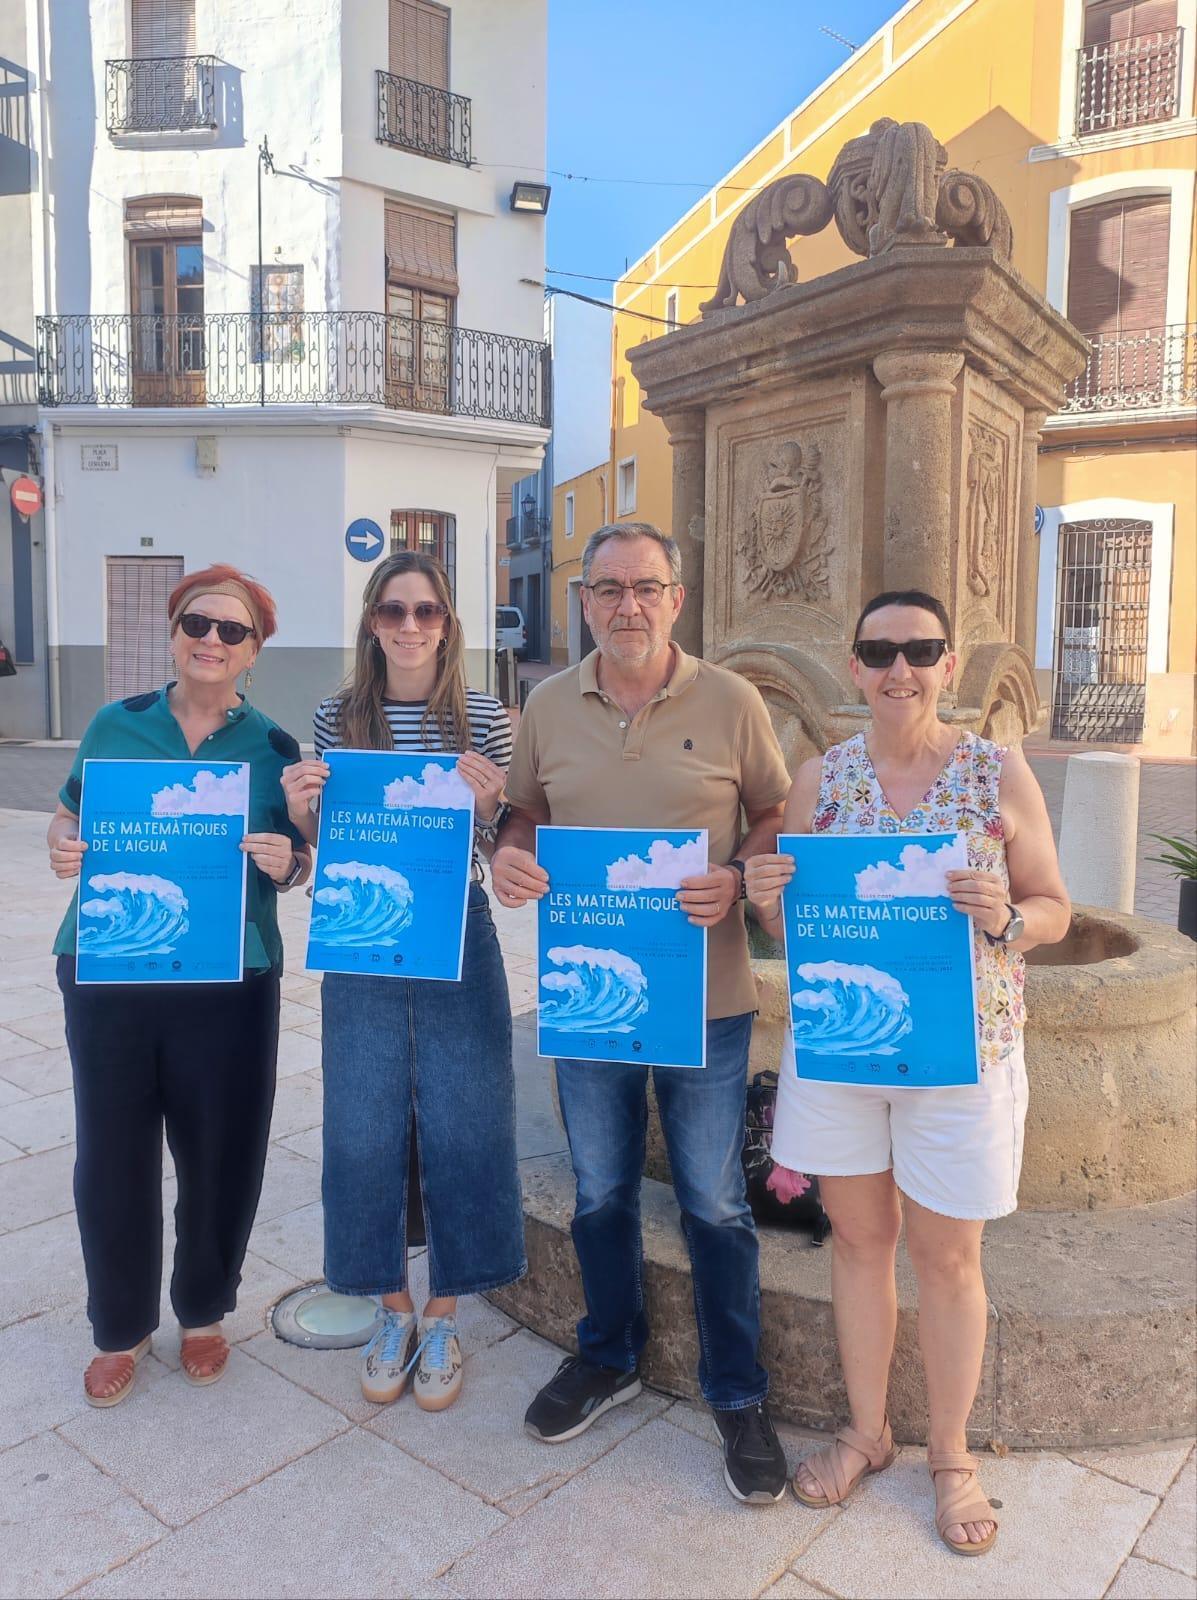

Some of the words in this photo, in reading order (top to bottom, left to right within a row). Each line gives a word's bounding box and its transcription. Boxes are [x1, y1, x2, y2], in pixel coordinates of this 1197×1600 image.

[92, 821, 115, 835] LES
[120, 819, 228, 836] MATEMÀTIQUES
[331, 810, 351, 824] LES
[355, 811, 454, 830] MATEMÀTIQUES
[329, 828, 345, 841] DE
[349, 828, 398, 844] L'AIGUA
[92, 840, 109, 852] DE
[114, 840, 168, 853] L'AIGUA
[550, 893, 571, 907] LES
[576, 893, 681, 912] MATEMÀTIQUE
[550, 910, 566, 924] DE
[571, 911, 625, 927] L'AIGUA
[795, 904, 820, 919] LES
[824, 903, 948, 922] MATEMÀTIQUES
[797, 923, 816, 938] DE
[820, 924, 880, 940] L'AIGUA
